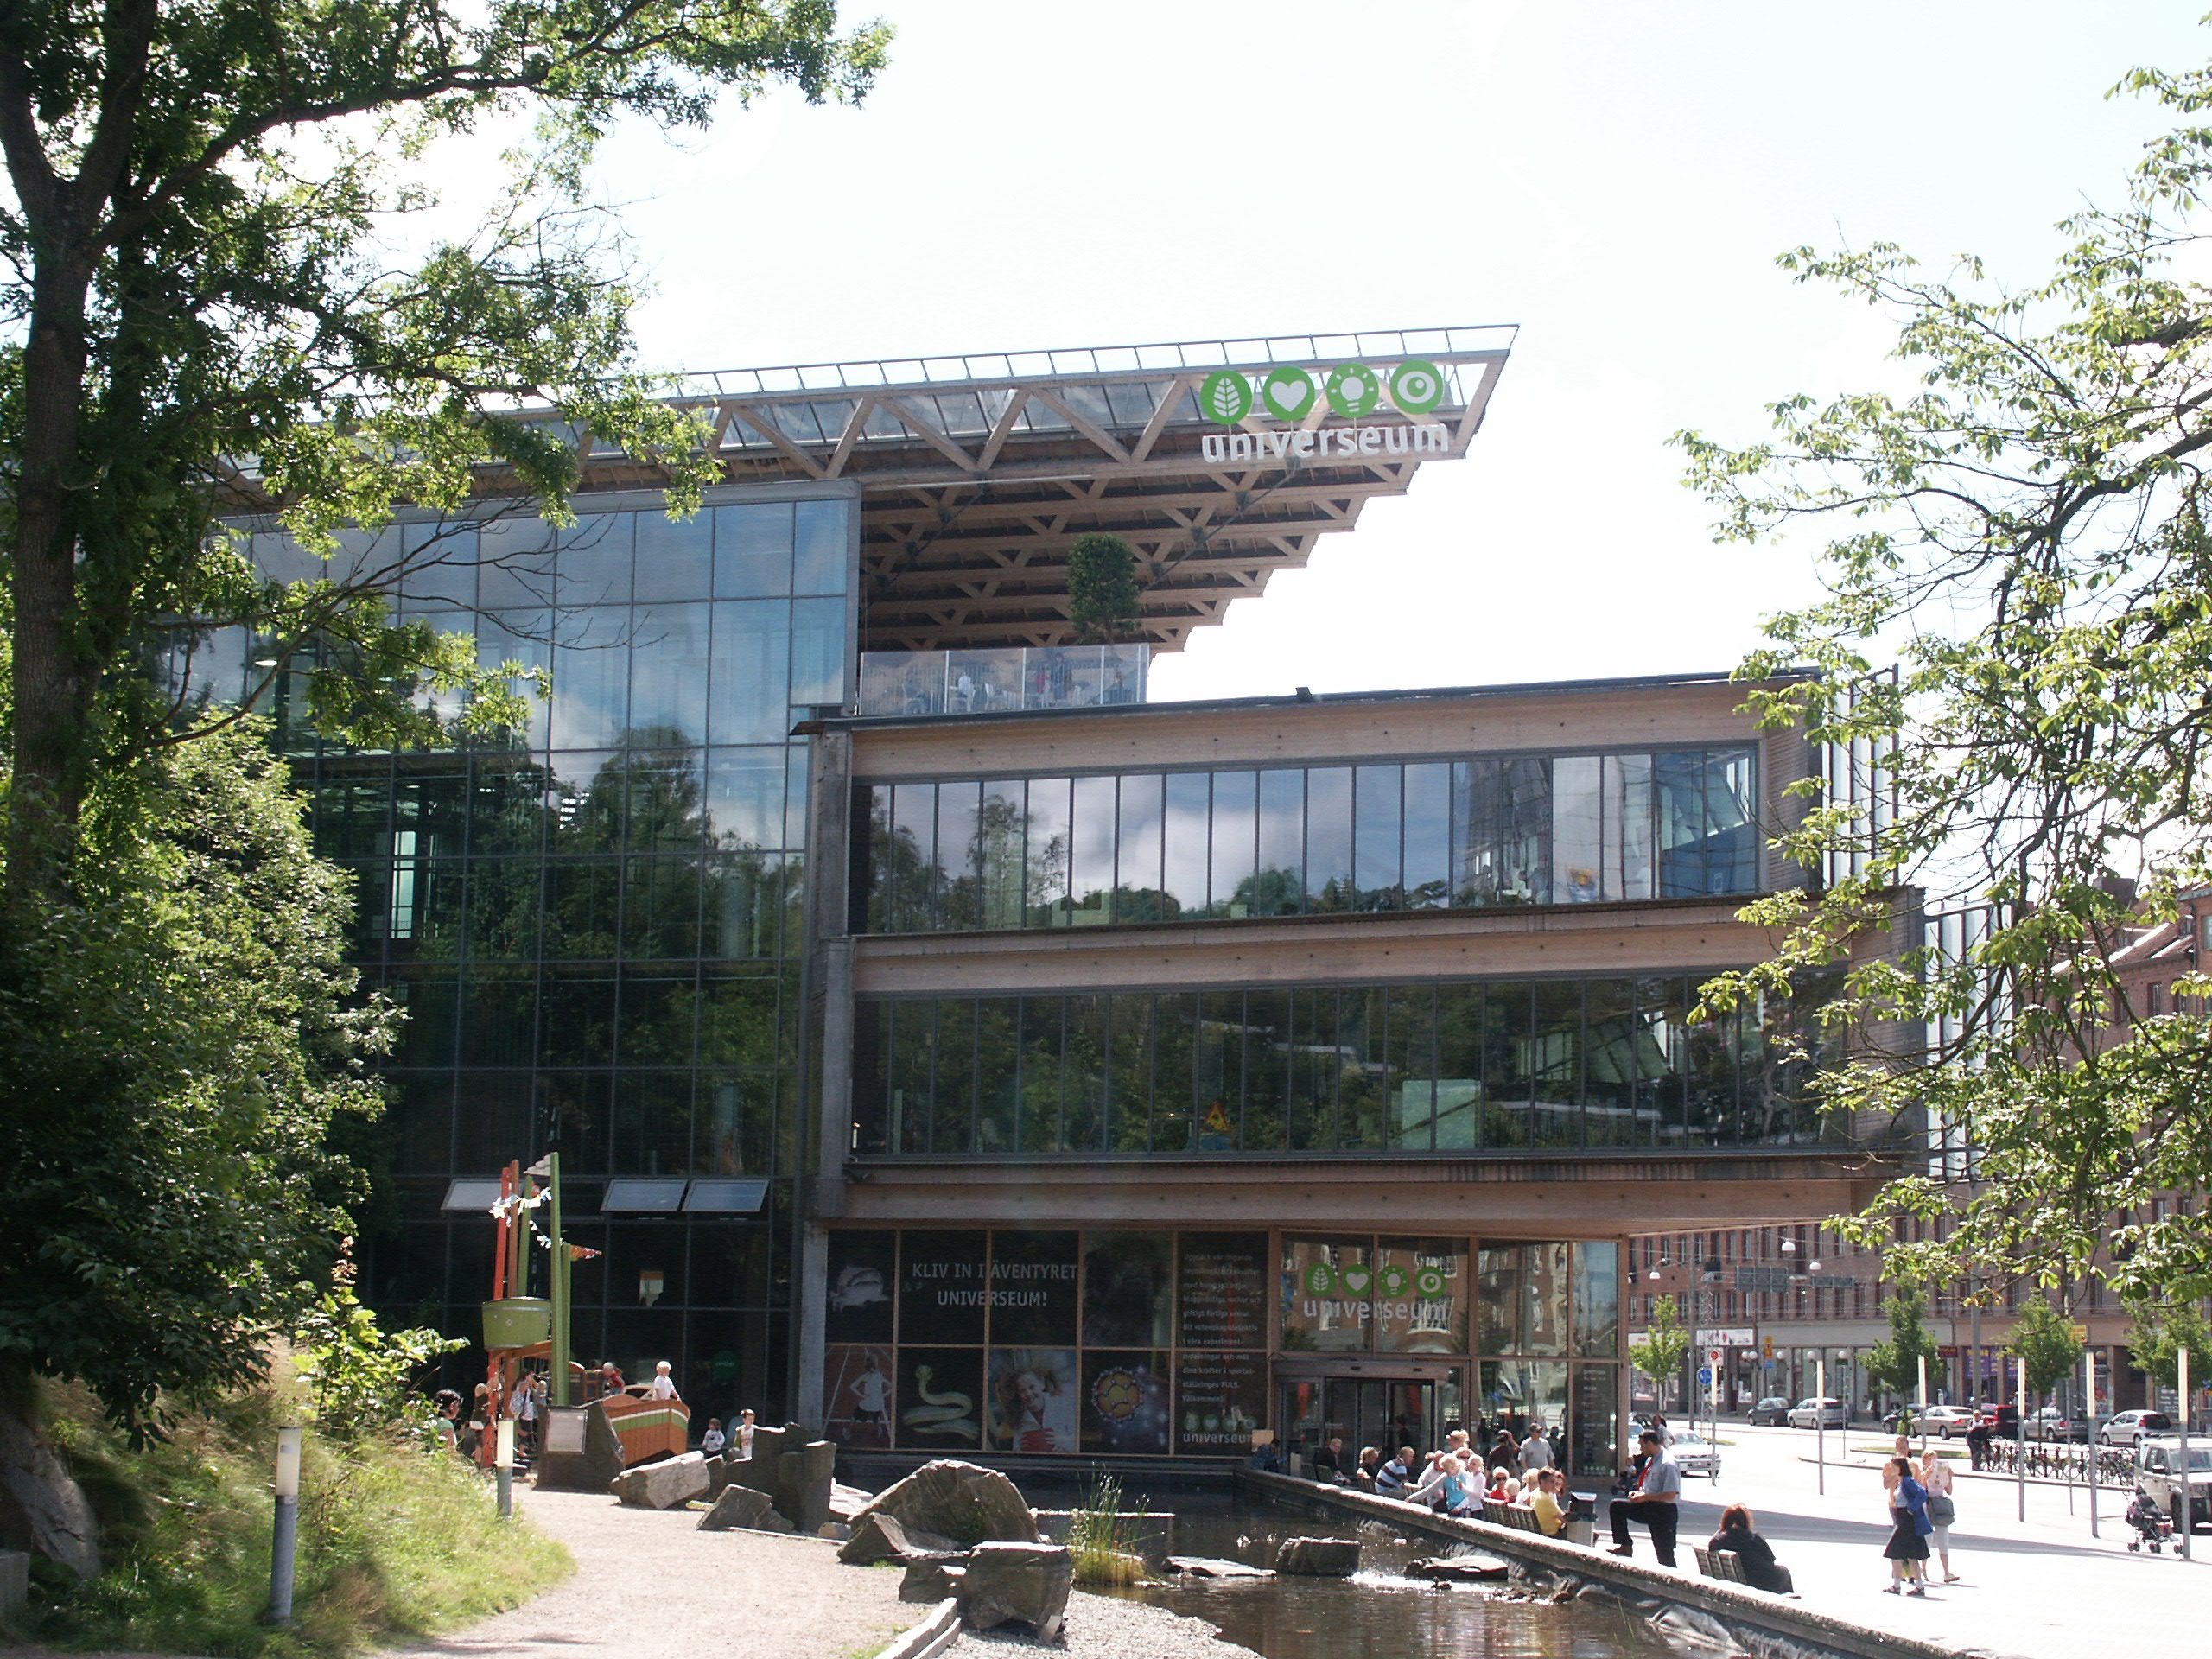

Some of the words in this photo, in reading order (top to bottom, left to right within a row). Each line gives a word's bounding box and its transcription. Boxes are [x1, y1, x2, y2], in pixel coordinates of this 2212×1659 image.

[1202, 423, 1449, 463] universeum
[912, 1263, 949, 1279] KLIV
[955, 1263, 971, 1278] IN
[977, 1264, 984, 1278] I
[990, 1260, 1077, 1280] ÄVENTYRET
[938, 1290, 1047, 1306] UNIVERSEUM!
[1303, 1299, 1446, 1321] universeum
